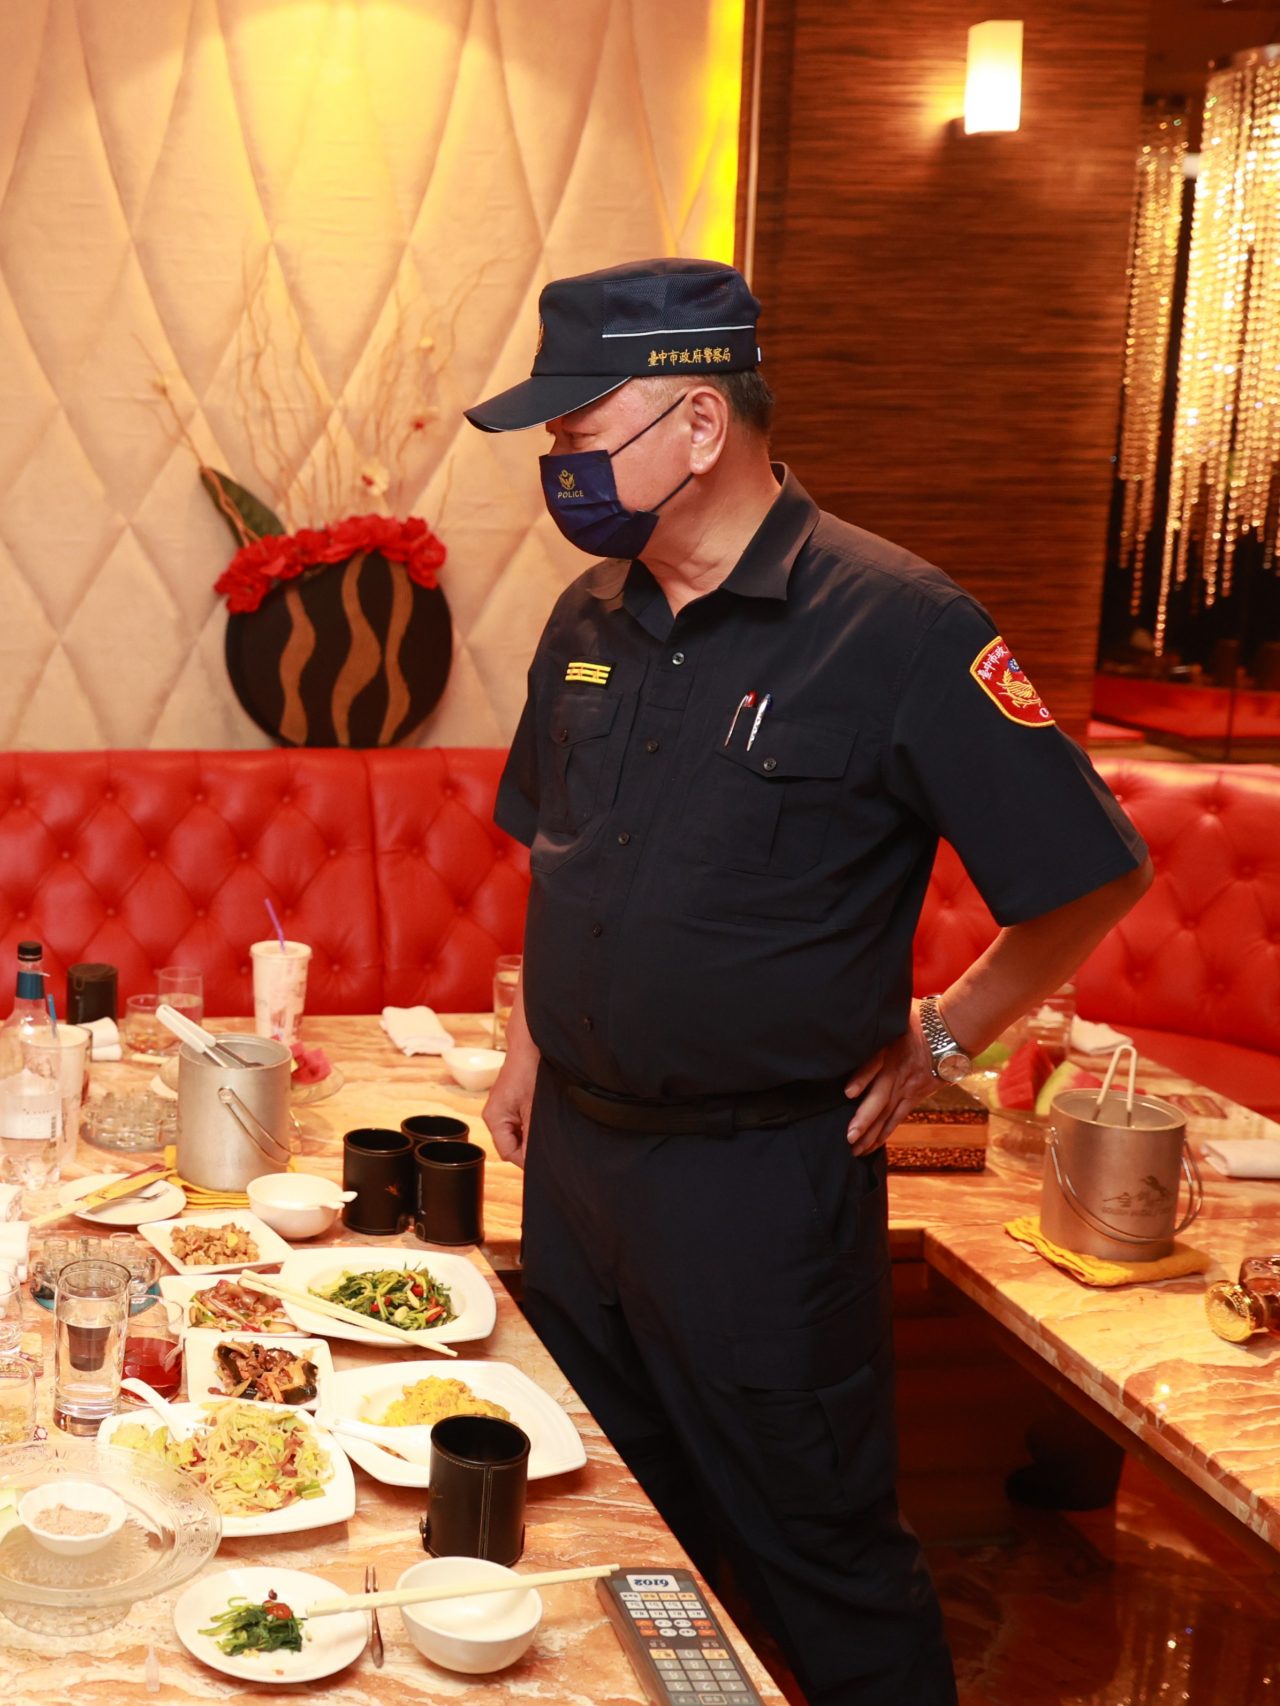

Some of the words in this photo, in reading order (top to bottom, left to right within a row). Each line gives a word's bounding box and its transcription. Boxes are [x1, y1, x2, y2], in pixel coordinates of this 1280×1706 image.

[647, 347, 731, 367] 臺中市政府警察局
[557, 490, 584, 499] POLICE
[977, 645, 1009, 680] 臺中市政
[633, 1579, 670, 1588] 6102
